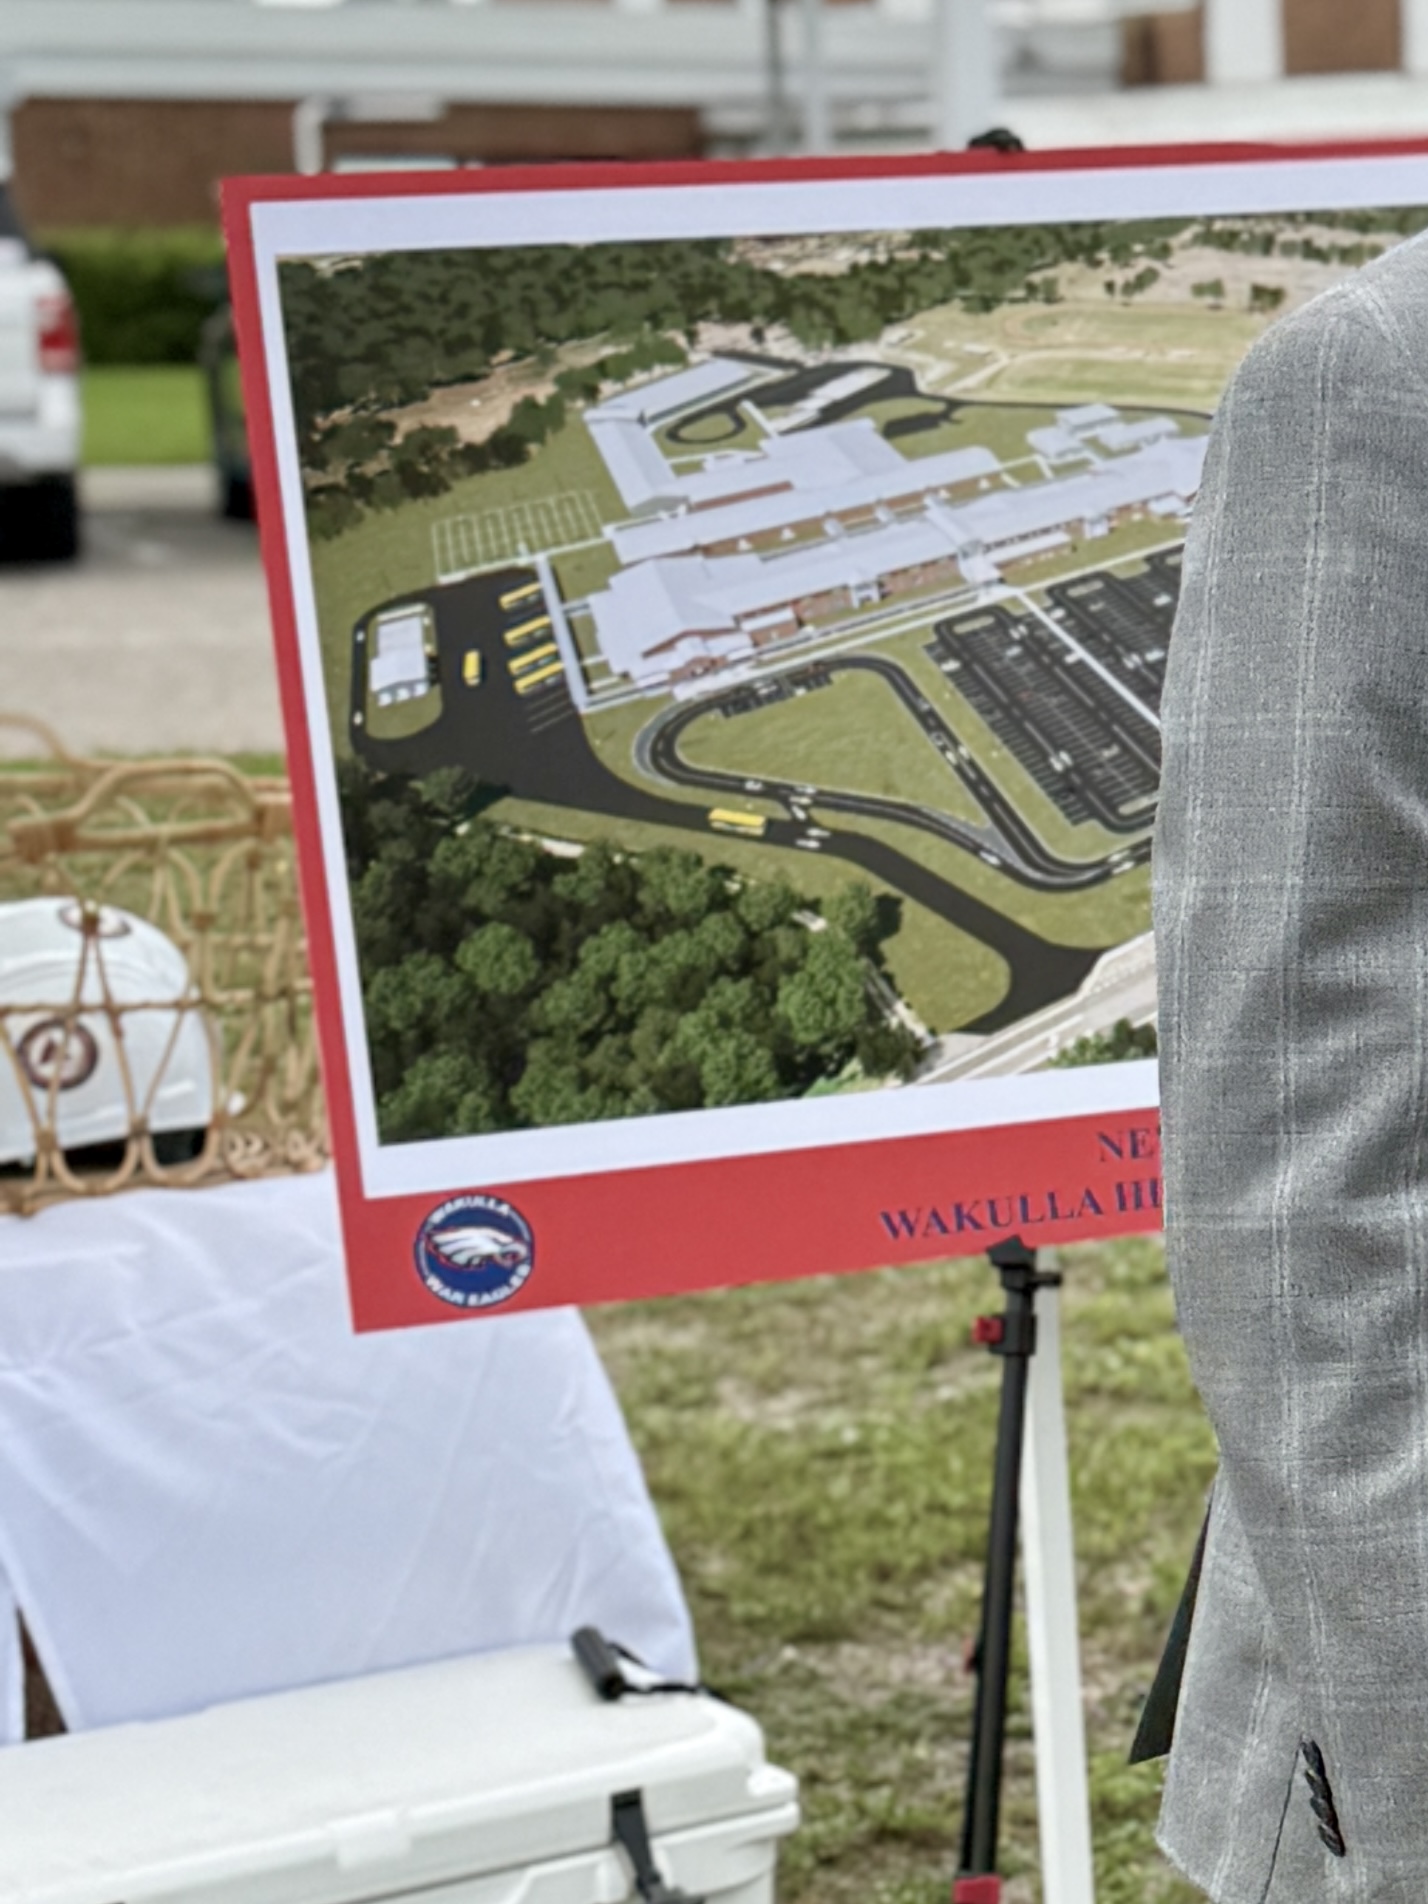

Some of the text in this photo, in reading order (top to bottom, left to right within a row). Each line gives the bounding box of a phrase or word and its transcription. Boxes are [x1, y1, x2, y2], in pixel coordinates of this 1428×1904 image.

[1097, 1127, 1161, 1163] NE
[429, 1195, 511, 1224] WAKULLA
[880, 1178, 1162, 1239] WAKULLA HI
[426, 1263, 532, 1307] WAR EAGLES
